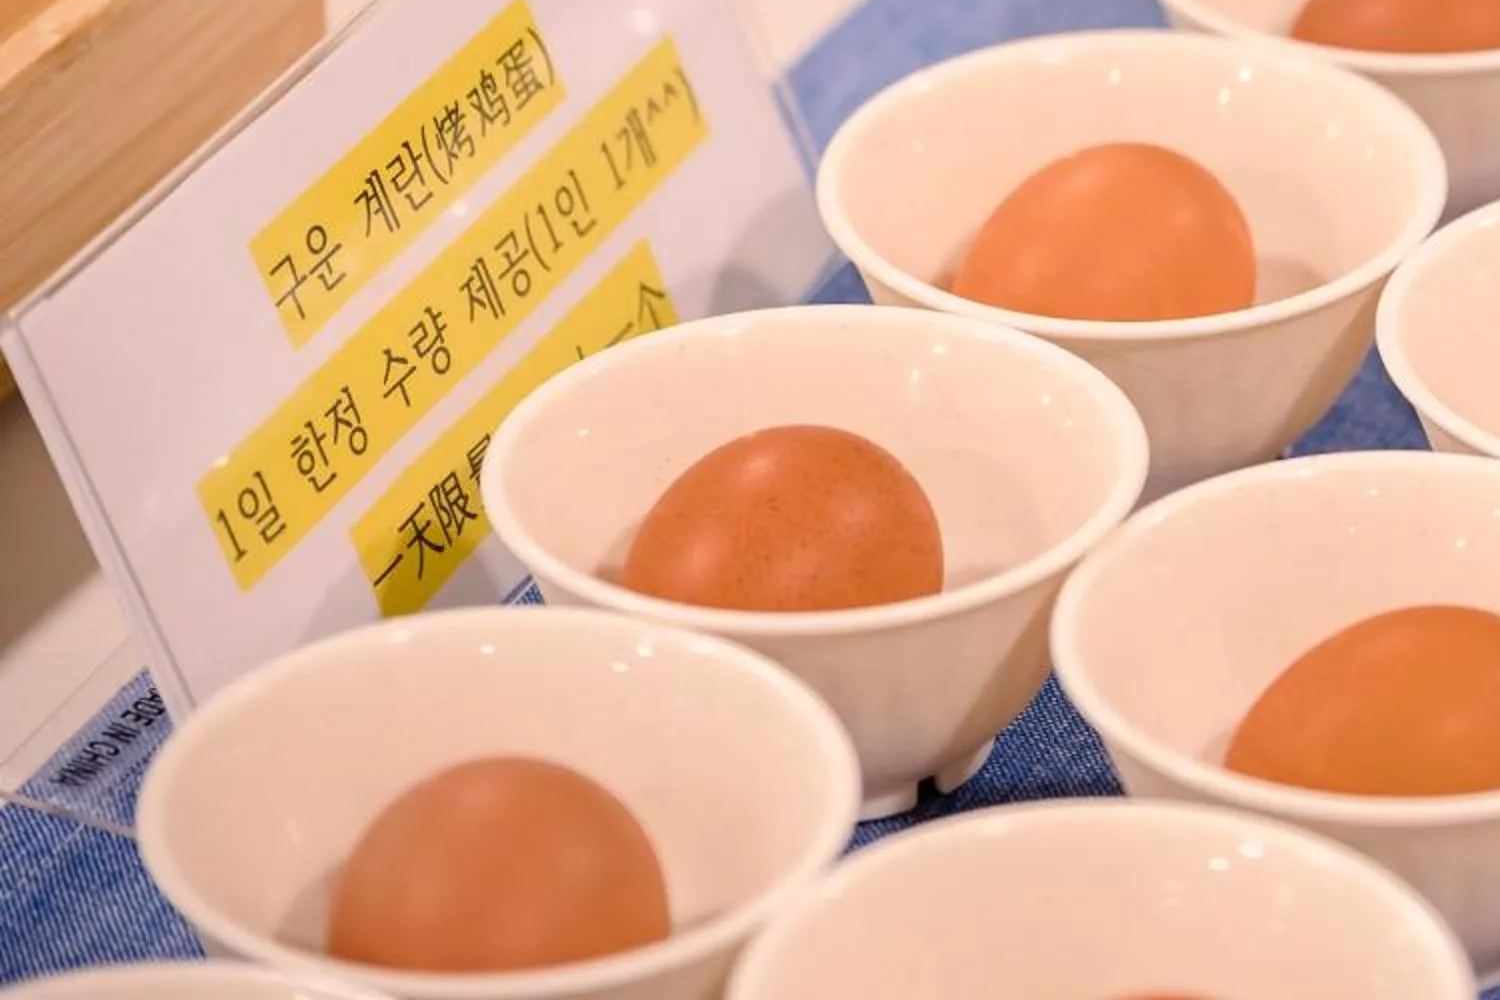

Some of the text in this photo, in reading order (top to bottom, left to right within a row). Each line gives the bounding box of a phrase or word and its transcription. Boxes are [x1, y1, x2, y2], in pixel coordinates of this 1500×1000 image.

[269, 224, 347, 320] 구운
[217, 470, 287, 562] 1일
[290, 386, 368, 493] 한정
[382, 306, 451, 408] 수량
[459, 169, 598, 323] 제공(1인
[50, 687, 166, 787] ADE IN CHINA
